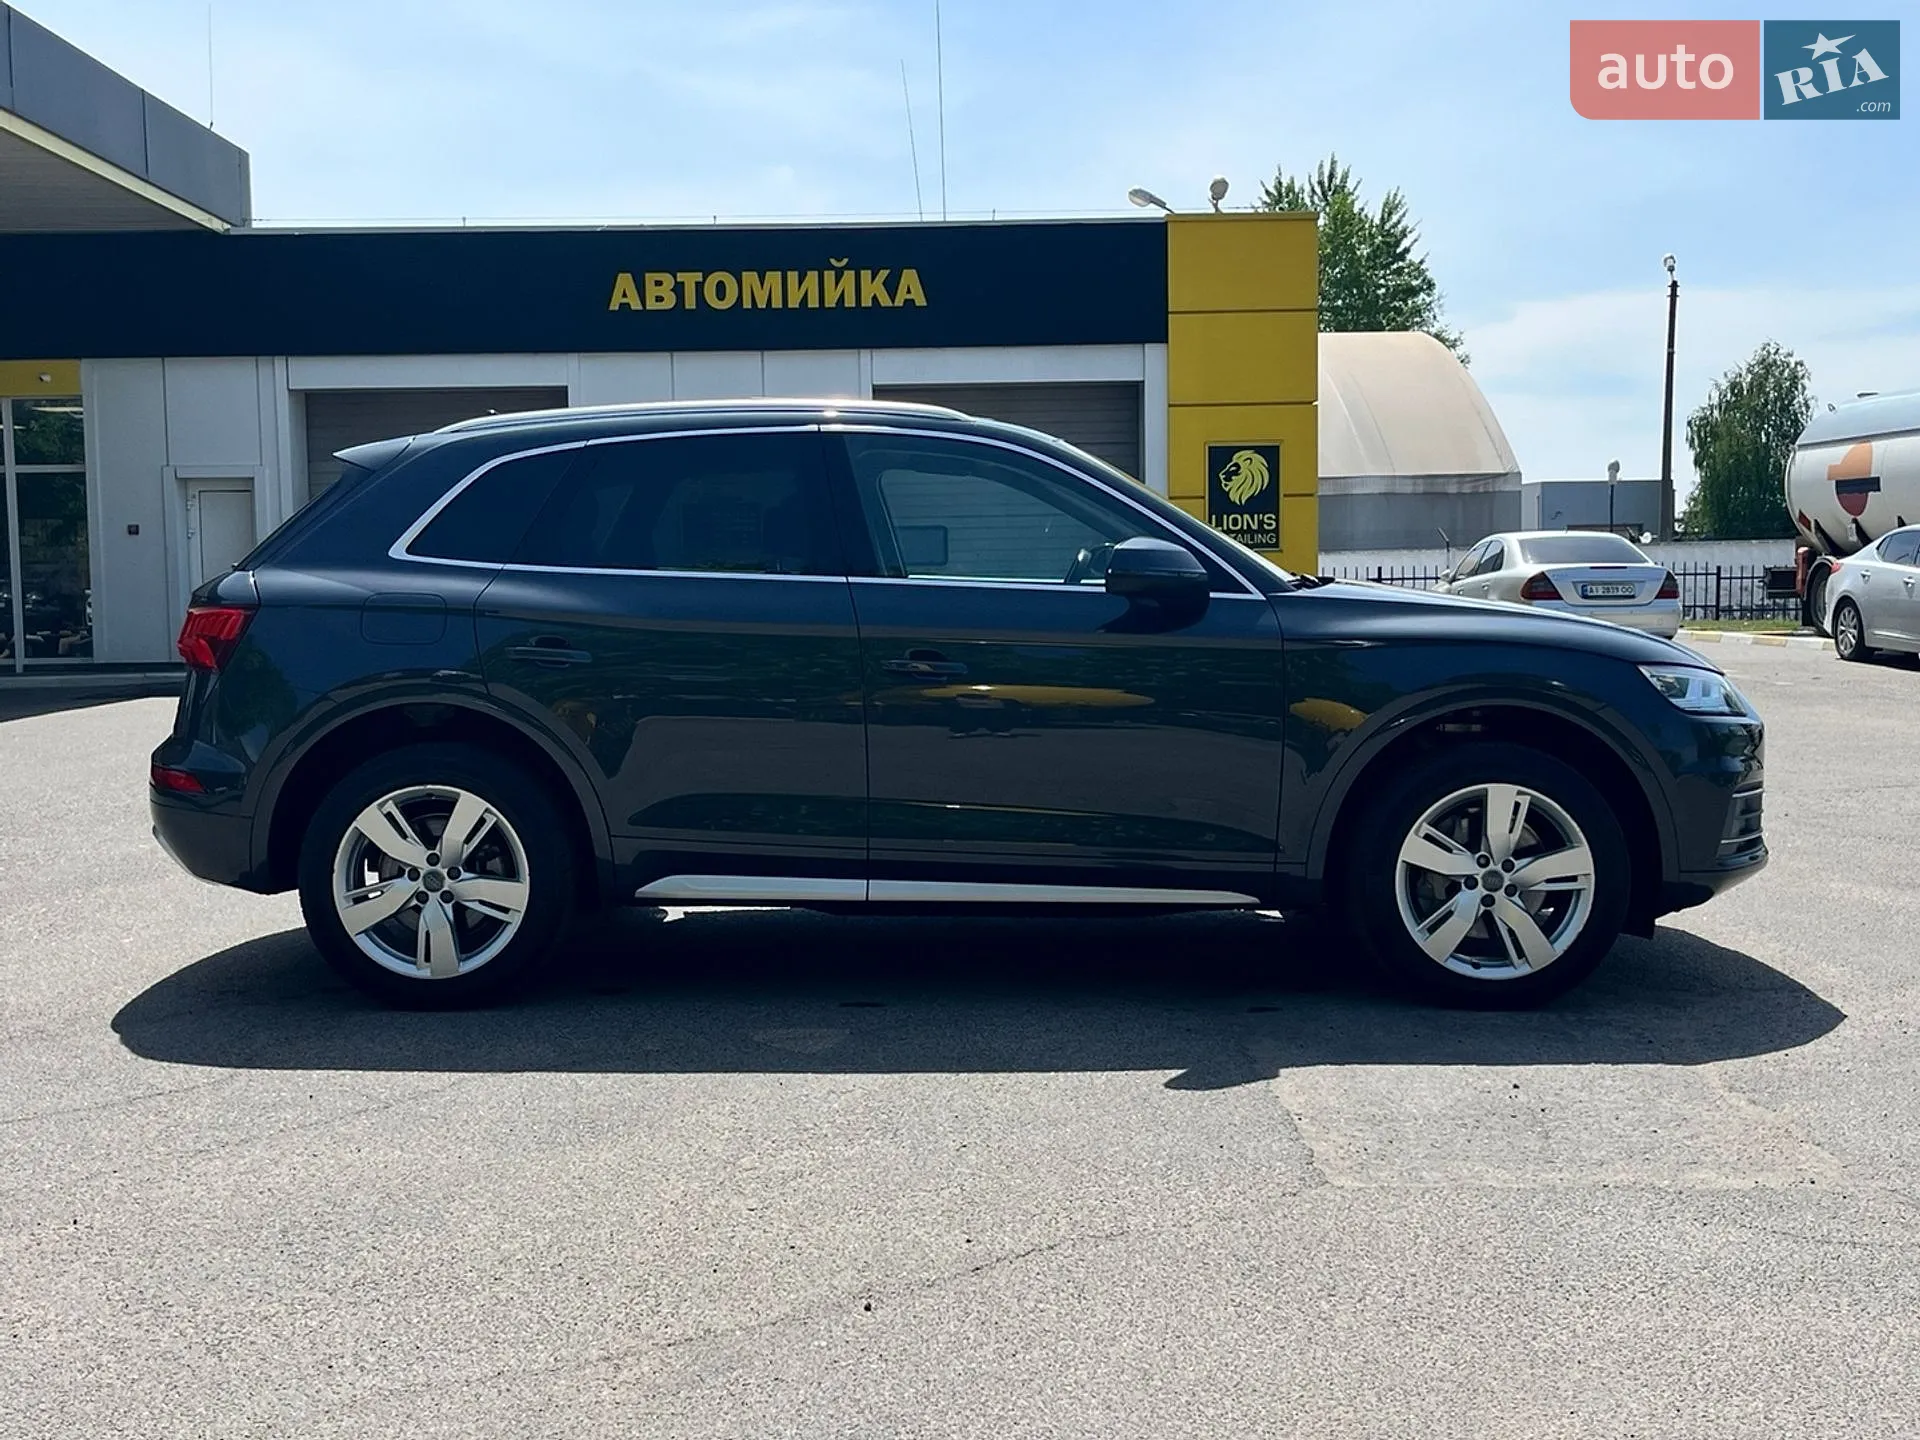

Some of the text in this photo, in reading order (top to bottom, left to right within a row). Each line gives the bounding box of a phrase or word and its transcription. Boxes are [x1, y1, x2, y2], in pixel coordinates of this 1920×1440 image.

[608, 257, 928, 311] АВТОМИЙКА
[1211, 513, 1277, 531] LION'S
[1229, 533, 1277, 544] AILING
